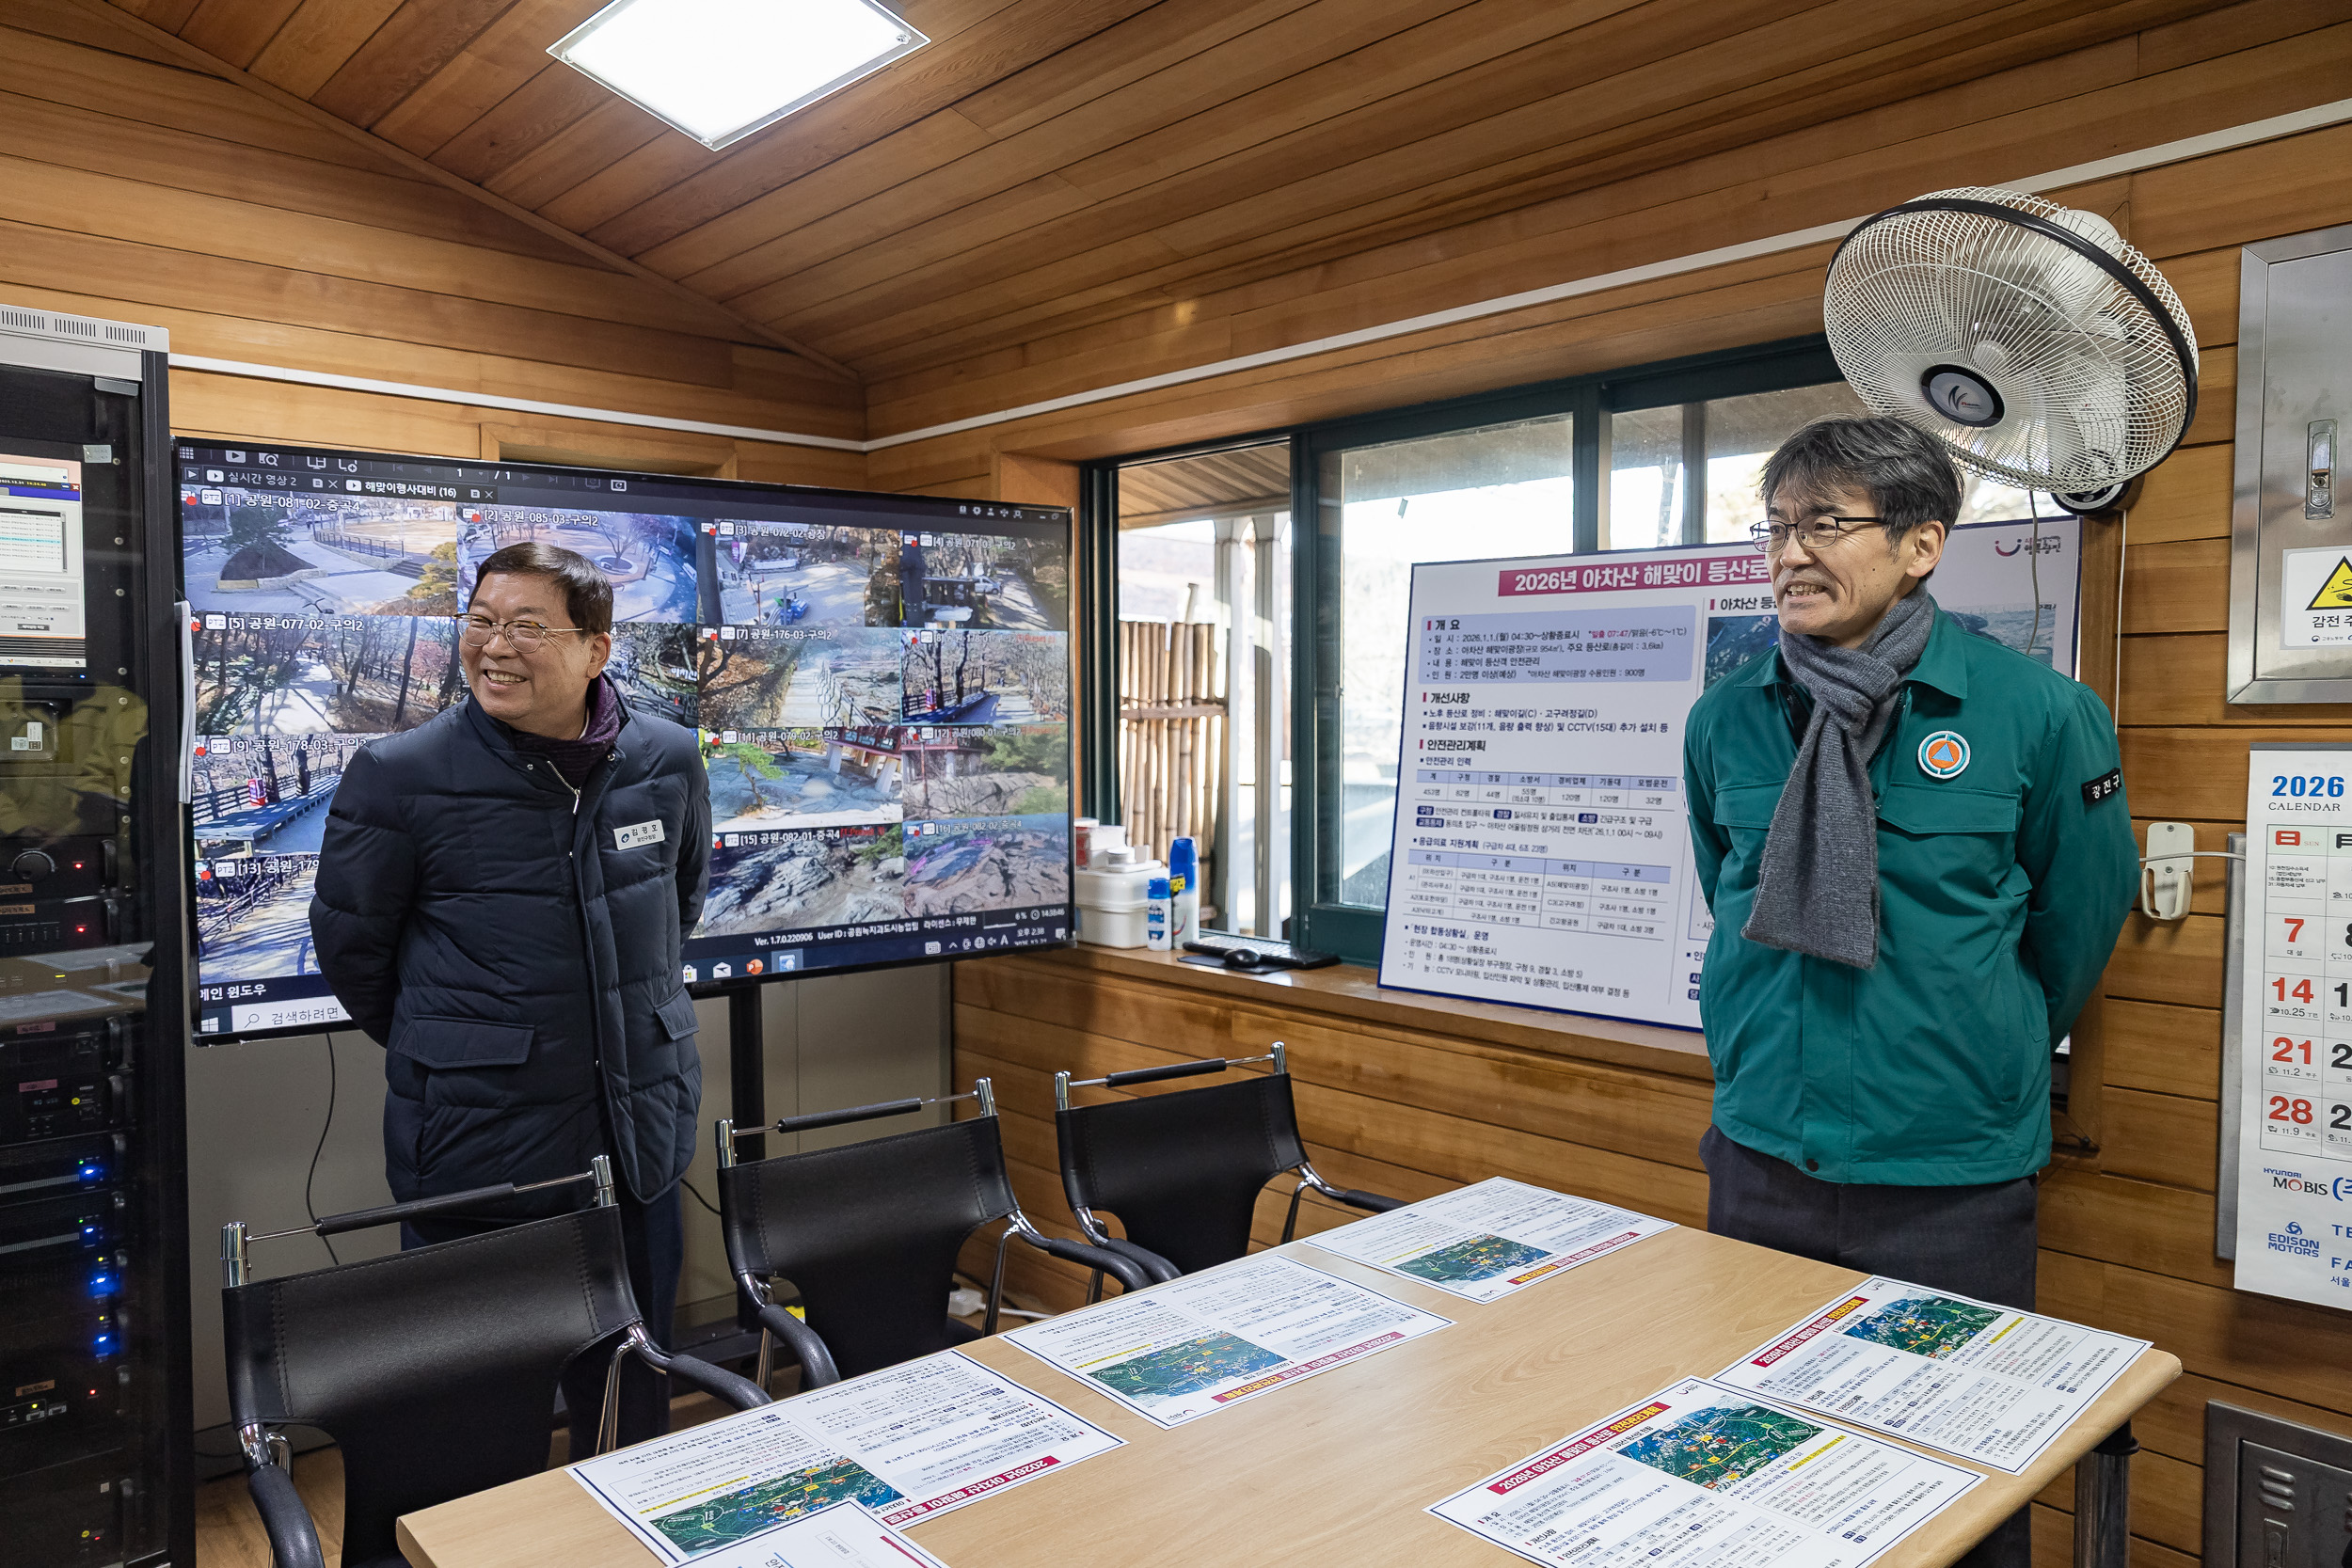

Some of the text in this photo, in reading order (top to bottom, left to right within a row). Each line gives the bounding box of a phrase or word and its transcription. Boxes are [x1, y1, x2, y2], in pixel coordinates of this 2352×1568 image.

[228, 472, 262, 485] 실시간
[266, 474, 287, 486] 영상
[365, 481, 457, 499] 해맞이행사대비 (16)
[224, 493, 241, 506] [1]
[246, 495, 359, 512] 공원-081-02-중곡4
[485, 509, 598, 527] [2] 공원-085-03-구의2
[736, 525, 747, 536] [3]
[1515, 559, 1769, 591] 2026년 아차산 해맞이 등산로
[1721, 597, 1777, 610] 아차산 등
[229, 618, 245, 630] [5]
[248, 618, 363, 632] 공원-077-02-구의2
[2312, 615, 2339, 628] 감전
[737, 628, 831, 641] [7] 공원-176-03-구의2
[1462, 646, 1484, 655] 아차산
[1567, 642, 1582, 652] 주요
[1461, 657, 1483, 667] 해맞이
[1486, 657, 1507, 666] 등산객
[1510, 657, 1540, 666] 안전관리
[1459, 671, 1479, 679] 2만명
[1431, 692, 1470, 704] 개선사항
[1429, 709, 1597, 719] 노후 등산로 정비 해맞이길(C) 고구려정길(D)
[1428, 722, 1457, 731] 음향시설
[1499, 722, 1514, 731] 음량
[1518, 722, 1532, 731] 출력
[1535, 722, 1553, 732] 향상)
[1557, 722, 1565, 732] 및
[1567, 722, 1616, 732] CCTV(15대)
[1620, 723, 1636, 732] 추가
[1640, 723, 1657, 733] 설치
[1661, 723, 1668, 733] 등
[233, 740, 249, 752] [9]
[1427, 739, 1486, 752] 안전관리계획
[1425, 757, 1471, 767] 안전관리 인력
[1488, 774, 1501, 783] 경찰
[1519, 775, 1540, 784] 소방서
[1558, 777, 1586, 785] 경비업체
[1599, 778, 1621, 786] 기동대
[2092, 774, 2119, 799] 광진구
[2272, 776, 2344, 797] 2026
[2268, 802, 2341, 811] CALENDAR
[740, 835, 757, 846] [15]
[1419, 837, 1479, 849] 응급의료 지원계획
[2276, 831, 2300, 846] 日
[238, 863, 261, 876] [13]
[1474, 930, 1488, 941] 운영
[2284, 918, 2304, 942] 7
[755, 938, 769, 946] Ver.
[818, 931, 834, 940] User
[2272, 977, 2313, 1004] 14
[271, 1007, 339, 1024] 검색하려면
[2280, 1007, 2305, 1017] 10.25
[2272, 1037, 2312, 1065] 21
[2282, 1068, 2300, 1076] 11.2
[2269, 1096, 2312, 1124] 28
[2264, 1167, 2301, 1178] HYUNDAI
[2273, 1177, 2328, 1196] MOBIS
[2268, 1233, 2319, 1249] EDISON
[2268, 1243, 2319, 1258] MOTORS
[2330, 1276, 2350, 1288] 서울
[1499, 1405, 1663, 1491] 2026년 아차산 해맞이 등산로 안전관리계획
[886, 1460, 1048, 1524] 2026년 아차산 해맞이 등산로
